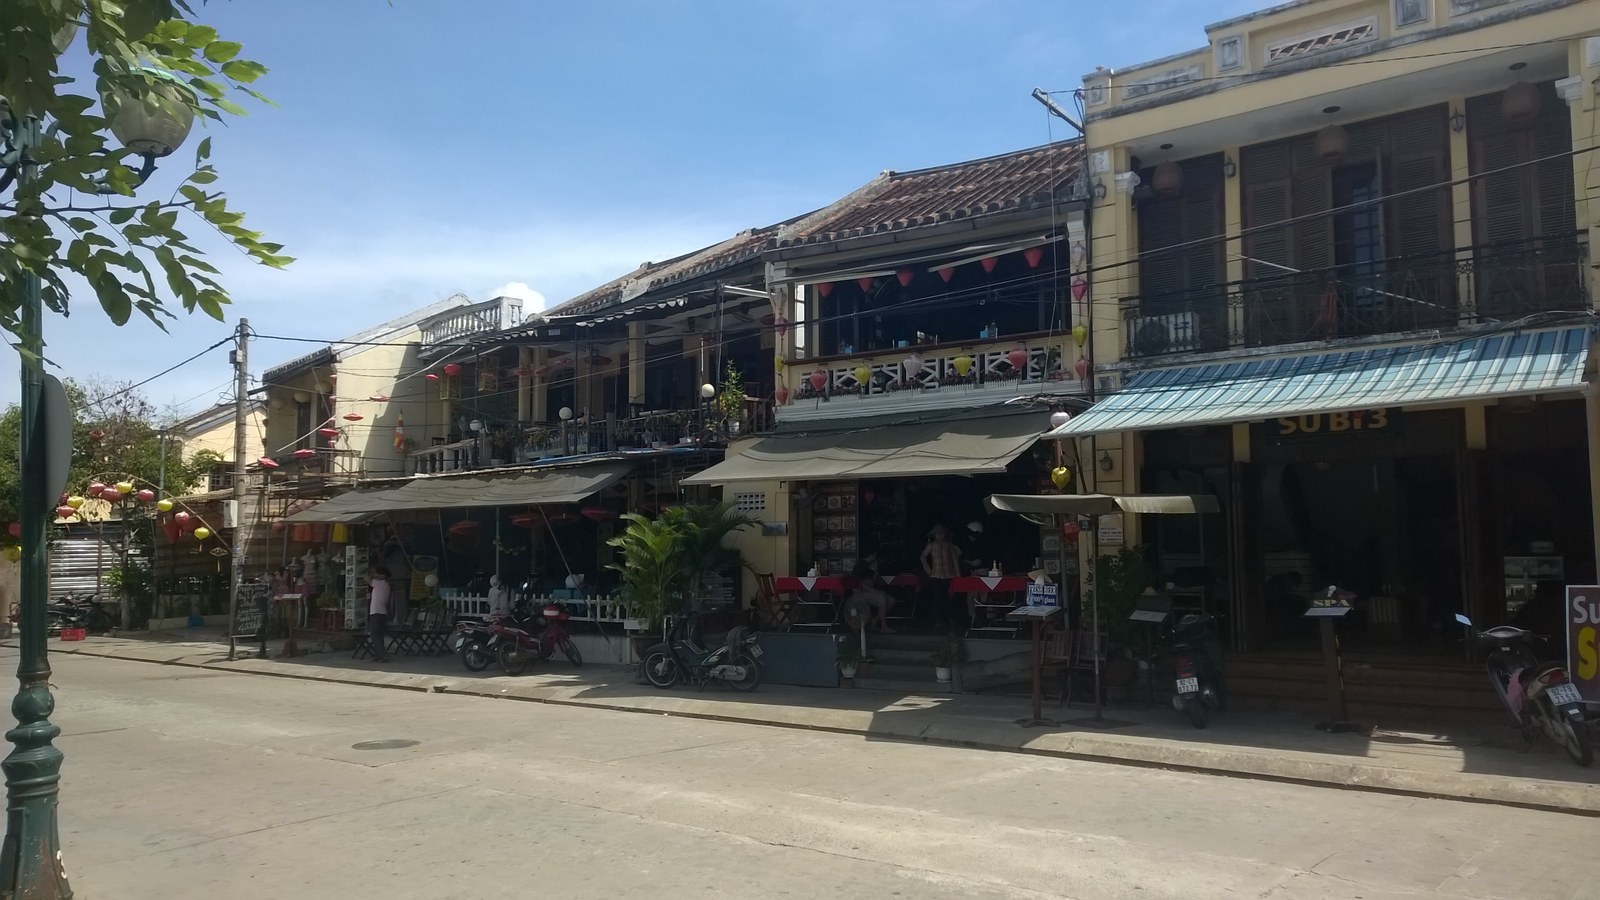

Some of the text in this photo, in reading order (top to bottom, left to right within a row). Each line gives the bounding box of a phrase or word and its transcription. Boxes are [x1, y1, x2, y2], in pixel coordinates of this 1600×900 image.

[1277, 414, 1321, 435] SU
[1368, 408, 1388, 429] 3
[1028, 585, 1056, 595] FRESH BEER
[1312, 599, 1350, 607] SPA
